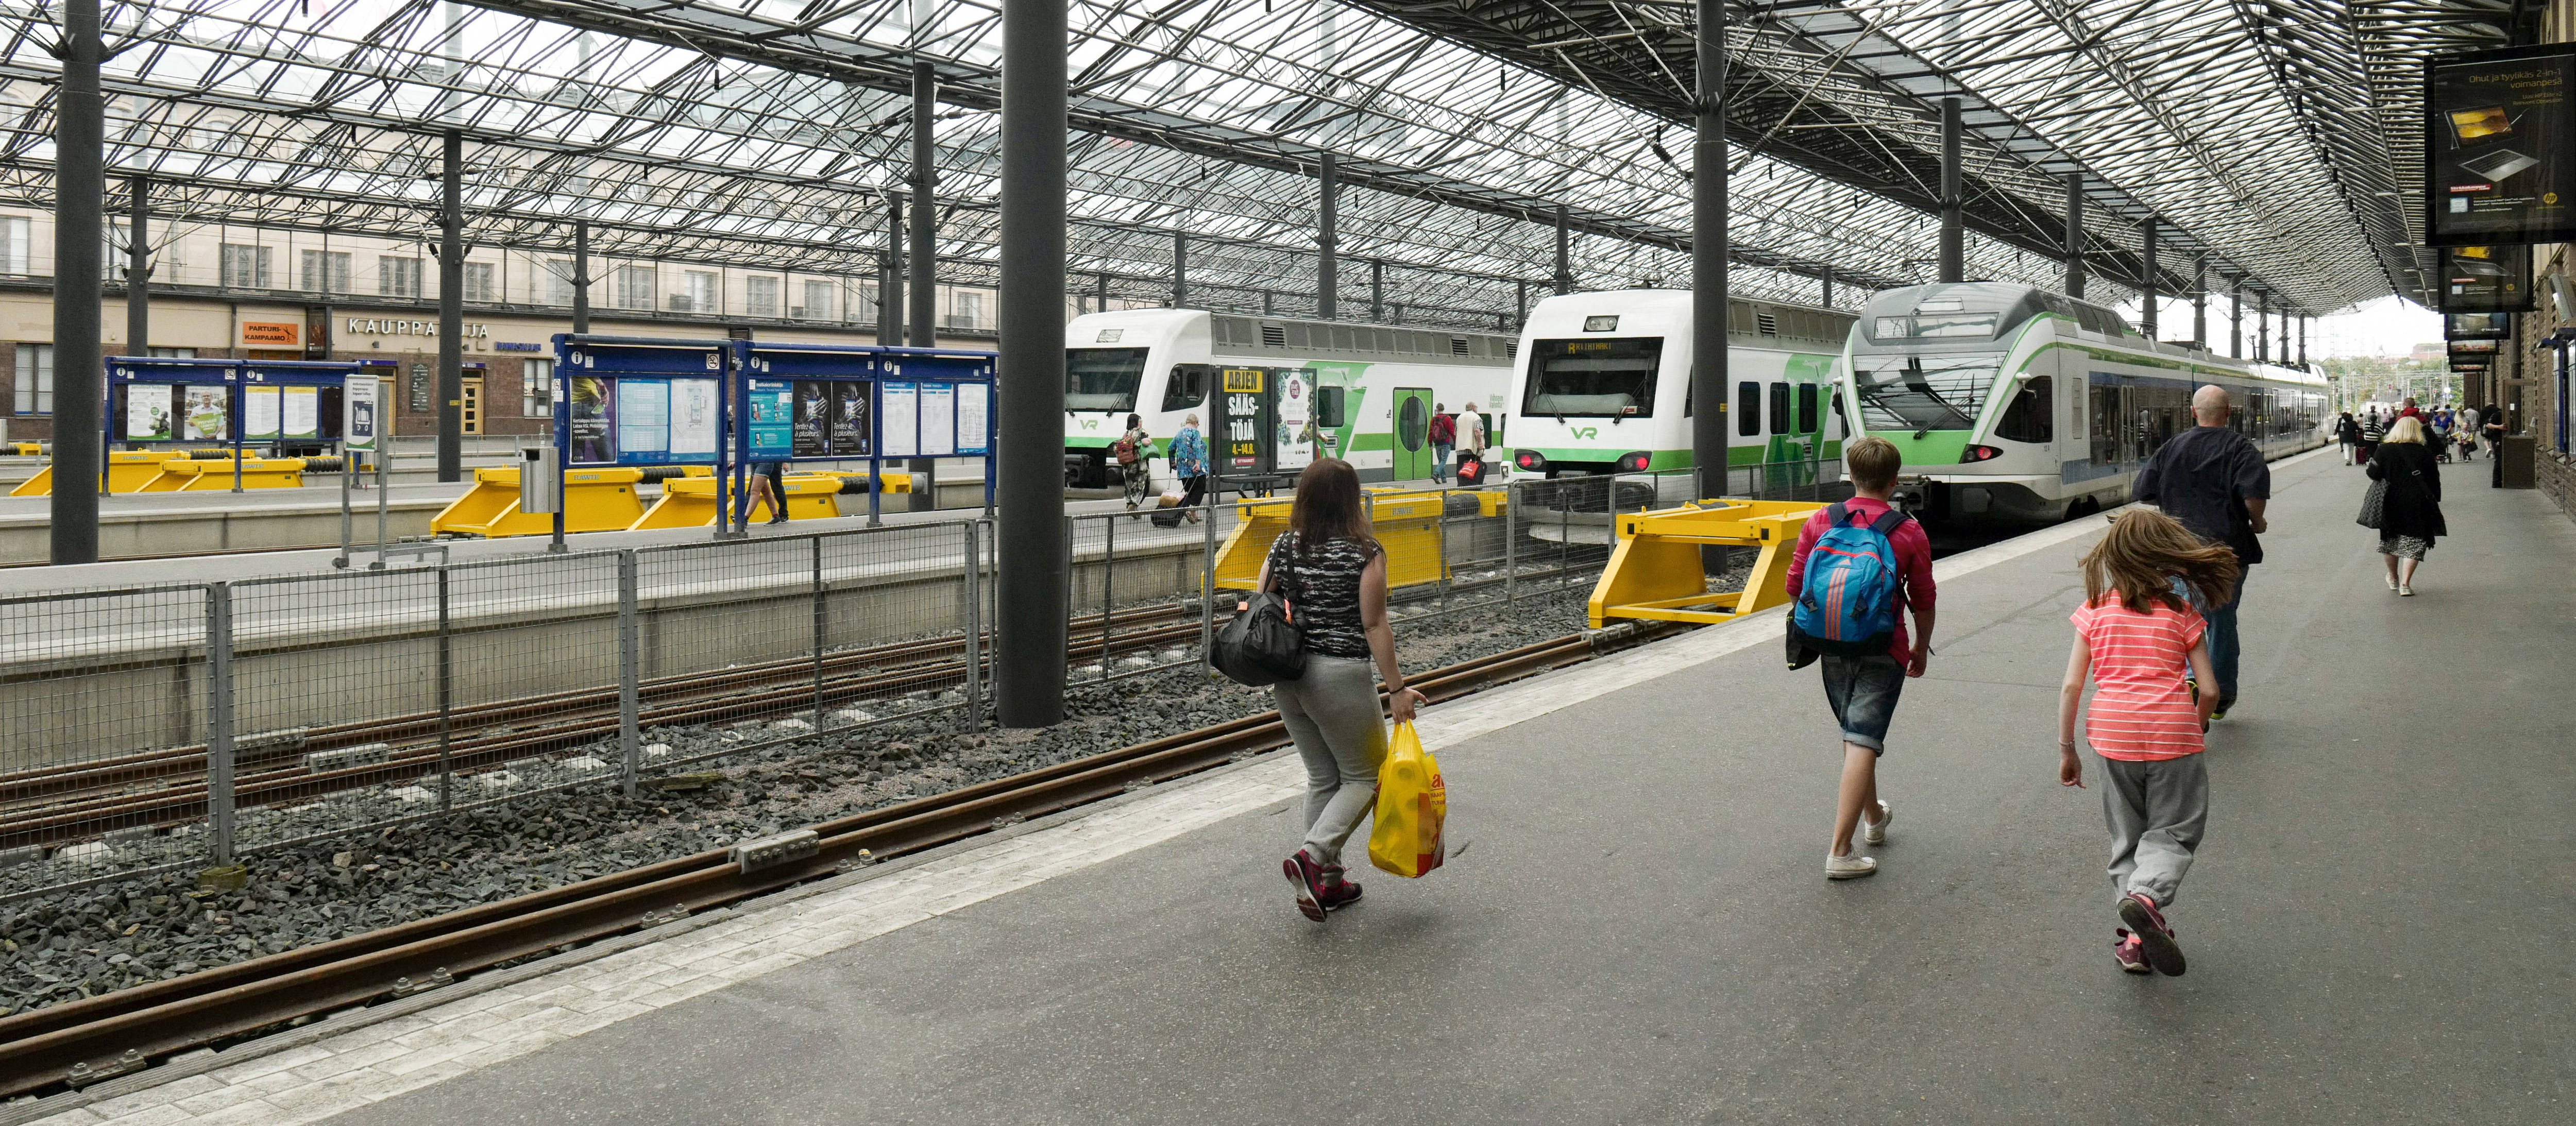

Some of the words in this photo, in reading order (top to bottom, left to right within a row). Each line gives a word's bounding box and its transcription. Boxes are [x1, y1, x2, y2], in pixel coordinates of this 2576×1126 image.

[2469, 75, 2489, 83] Ohut
[2502, 71, 2534, 80] tyylikäs
[2536, 68, 2561, 77] 2-in-1
[2511, 78, 2563, 89] voimanpesä
[349, 318, 488, 338] KAUPPAJA
[1227, 371, 1257, 390] ARJEN
[1228, 394, 1259, 415] SÄÄS-
[1080, 419, 1098, 430] VR
[1230, 419, 1254, 441] TÖJÄ
[1570, 427, 1598, 439] VR
